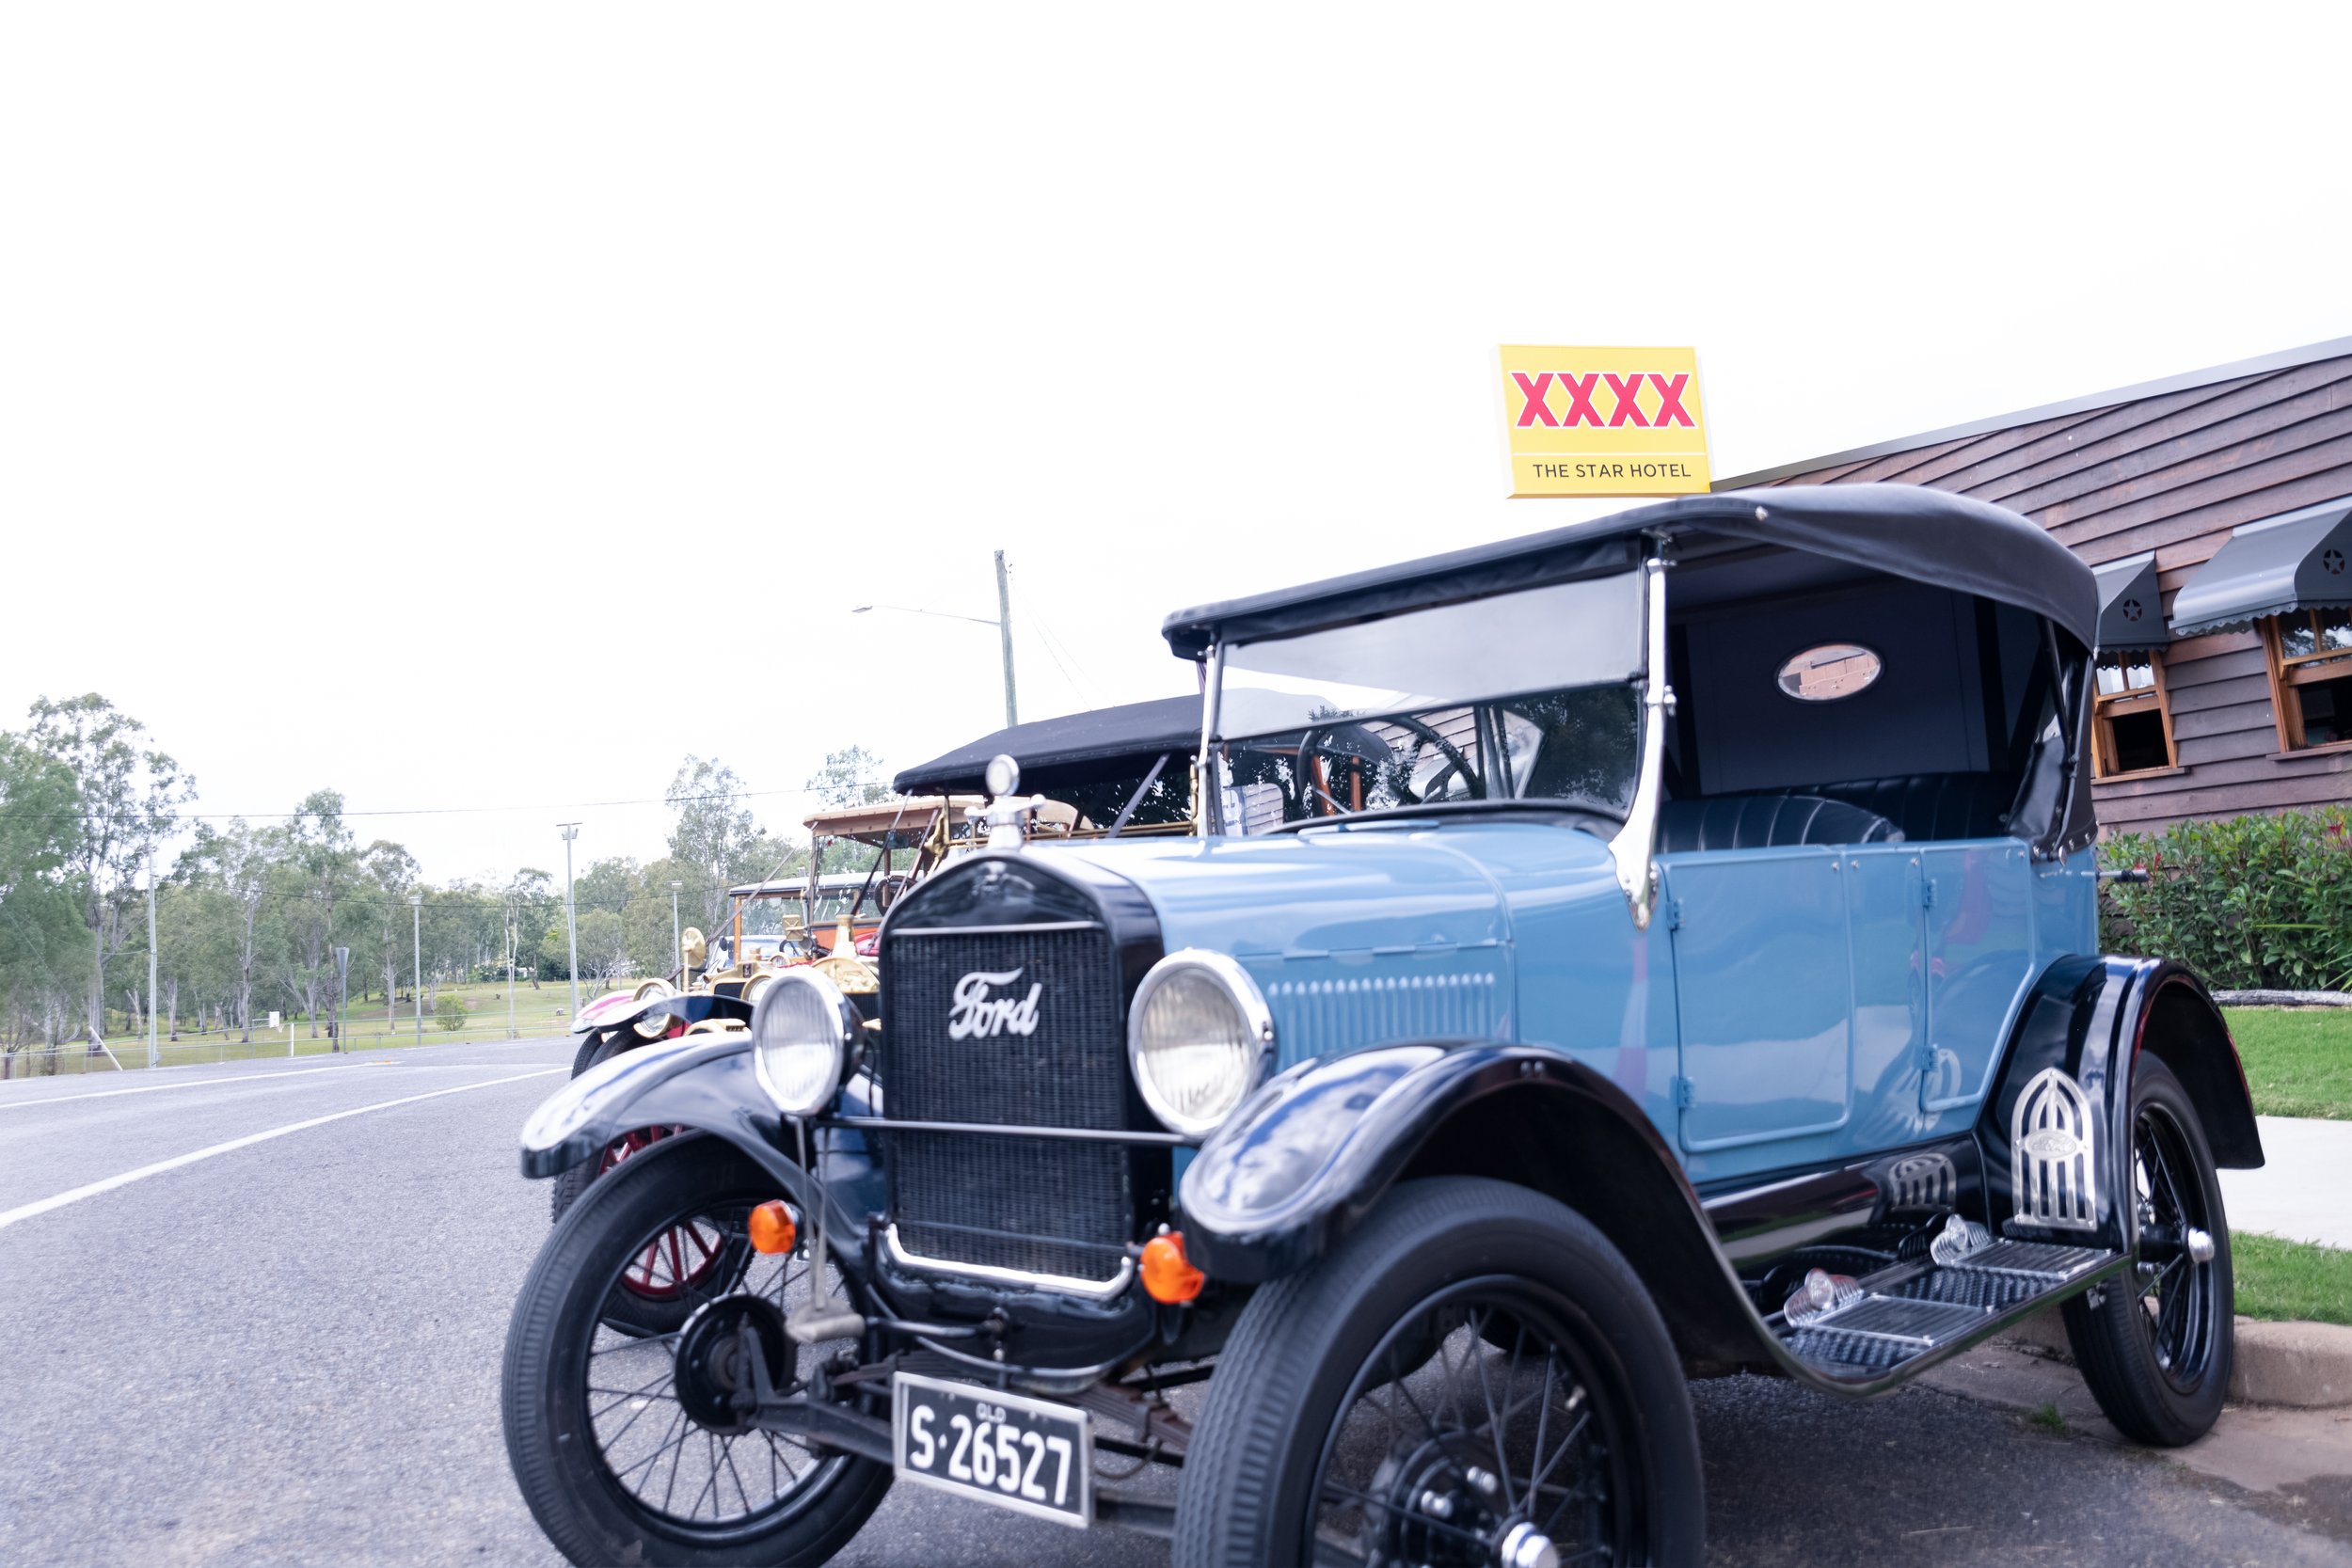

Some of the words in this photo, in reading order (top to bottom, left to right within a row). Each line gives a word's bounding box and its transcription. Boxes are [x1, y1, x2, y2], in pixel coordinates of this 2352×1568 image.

[1511, 372, 1695, 427] XXXX
[1533, 464, 1569, 478] THE
[1576, 464, 1624, 478] STAR
[1630, 464, 1692, 478] HOTEL
[948, 967, 1042, 1041] Ford
[976, 1402, 1007, 1424] QLD
